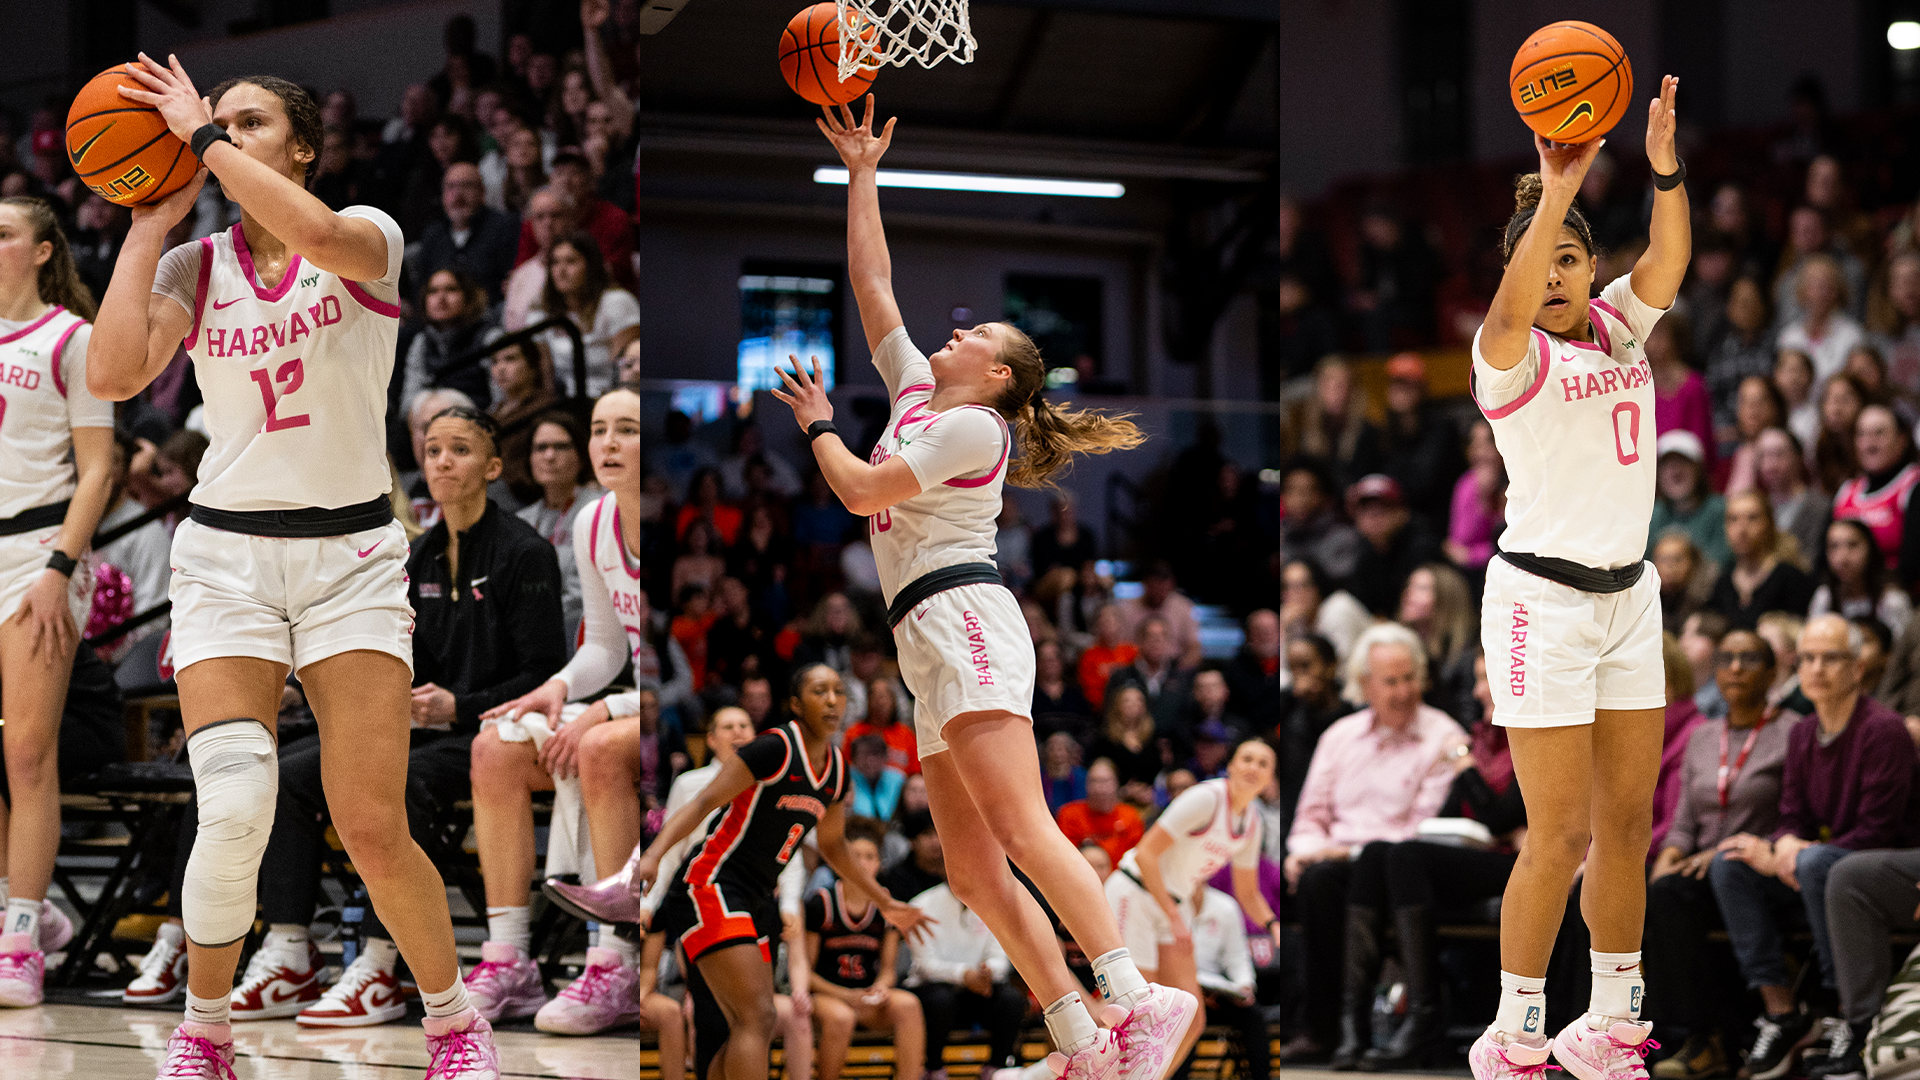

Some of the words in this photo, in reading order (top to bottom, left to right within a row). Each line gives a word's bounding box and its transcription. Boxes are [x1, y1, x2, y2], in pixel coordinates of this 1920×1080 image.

[1519, 68, 1578, 105] ELITE
[206, 294, 342, 358] HARVARD
[249, 357, 311, 434] 12
[1611, 401, 1641, 467] 0
[963, 610, 995, 686] HARVARD
[1510, 601, 1529, 697] HARVARD
[775, 822, 805, 865] 2
